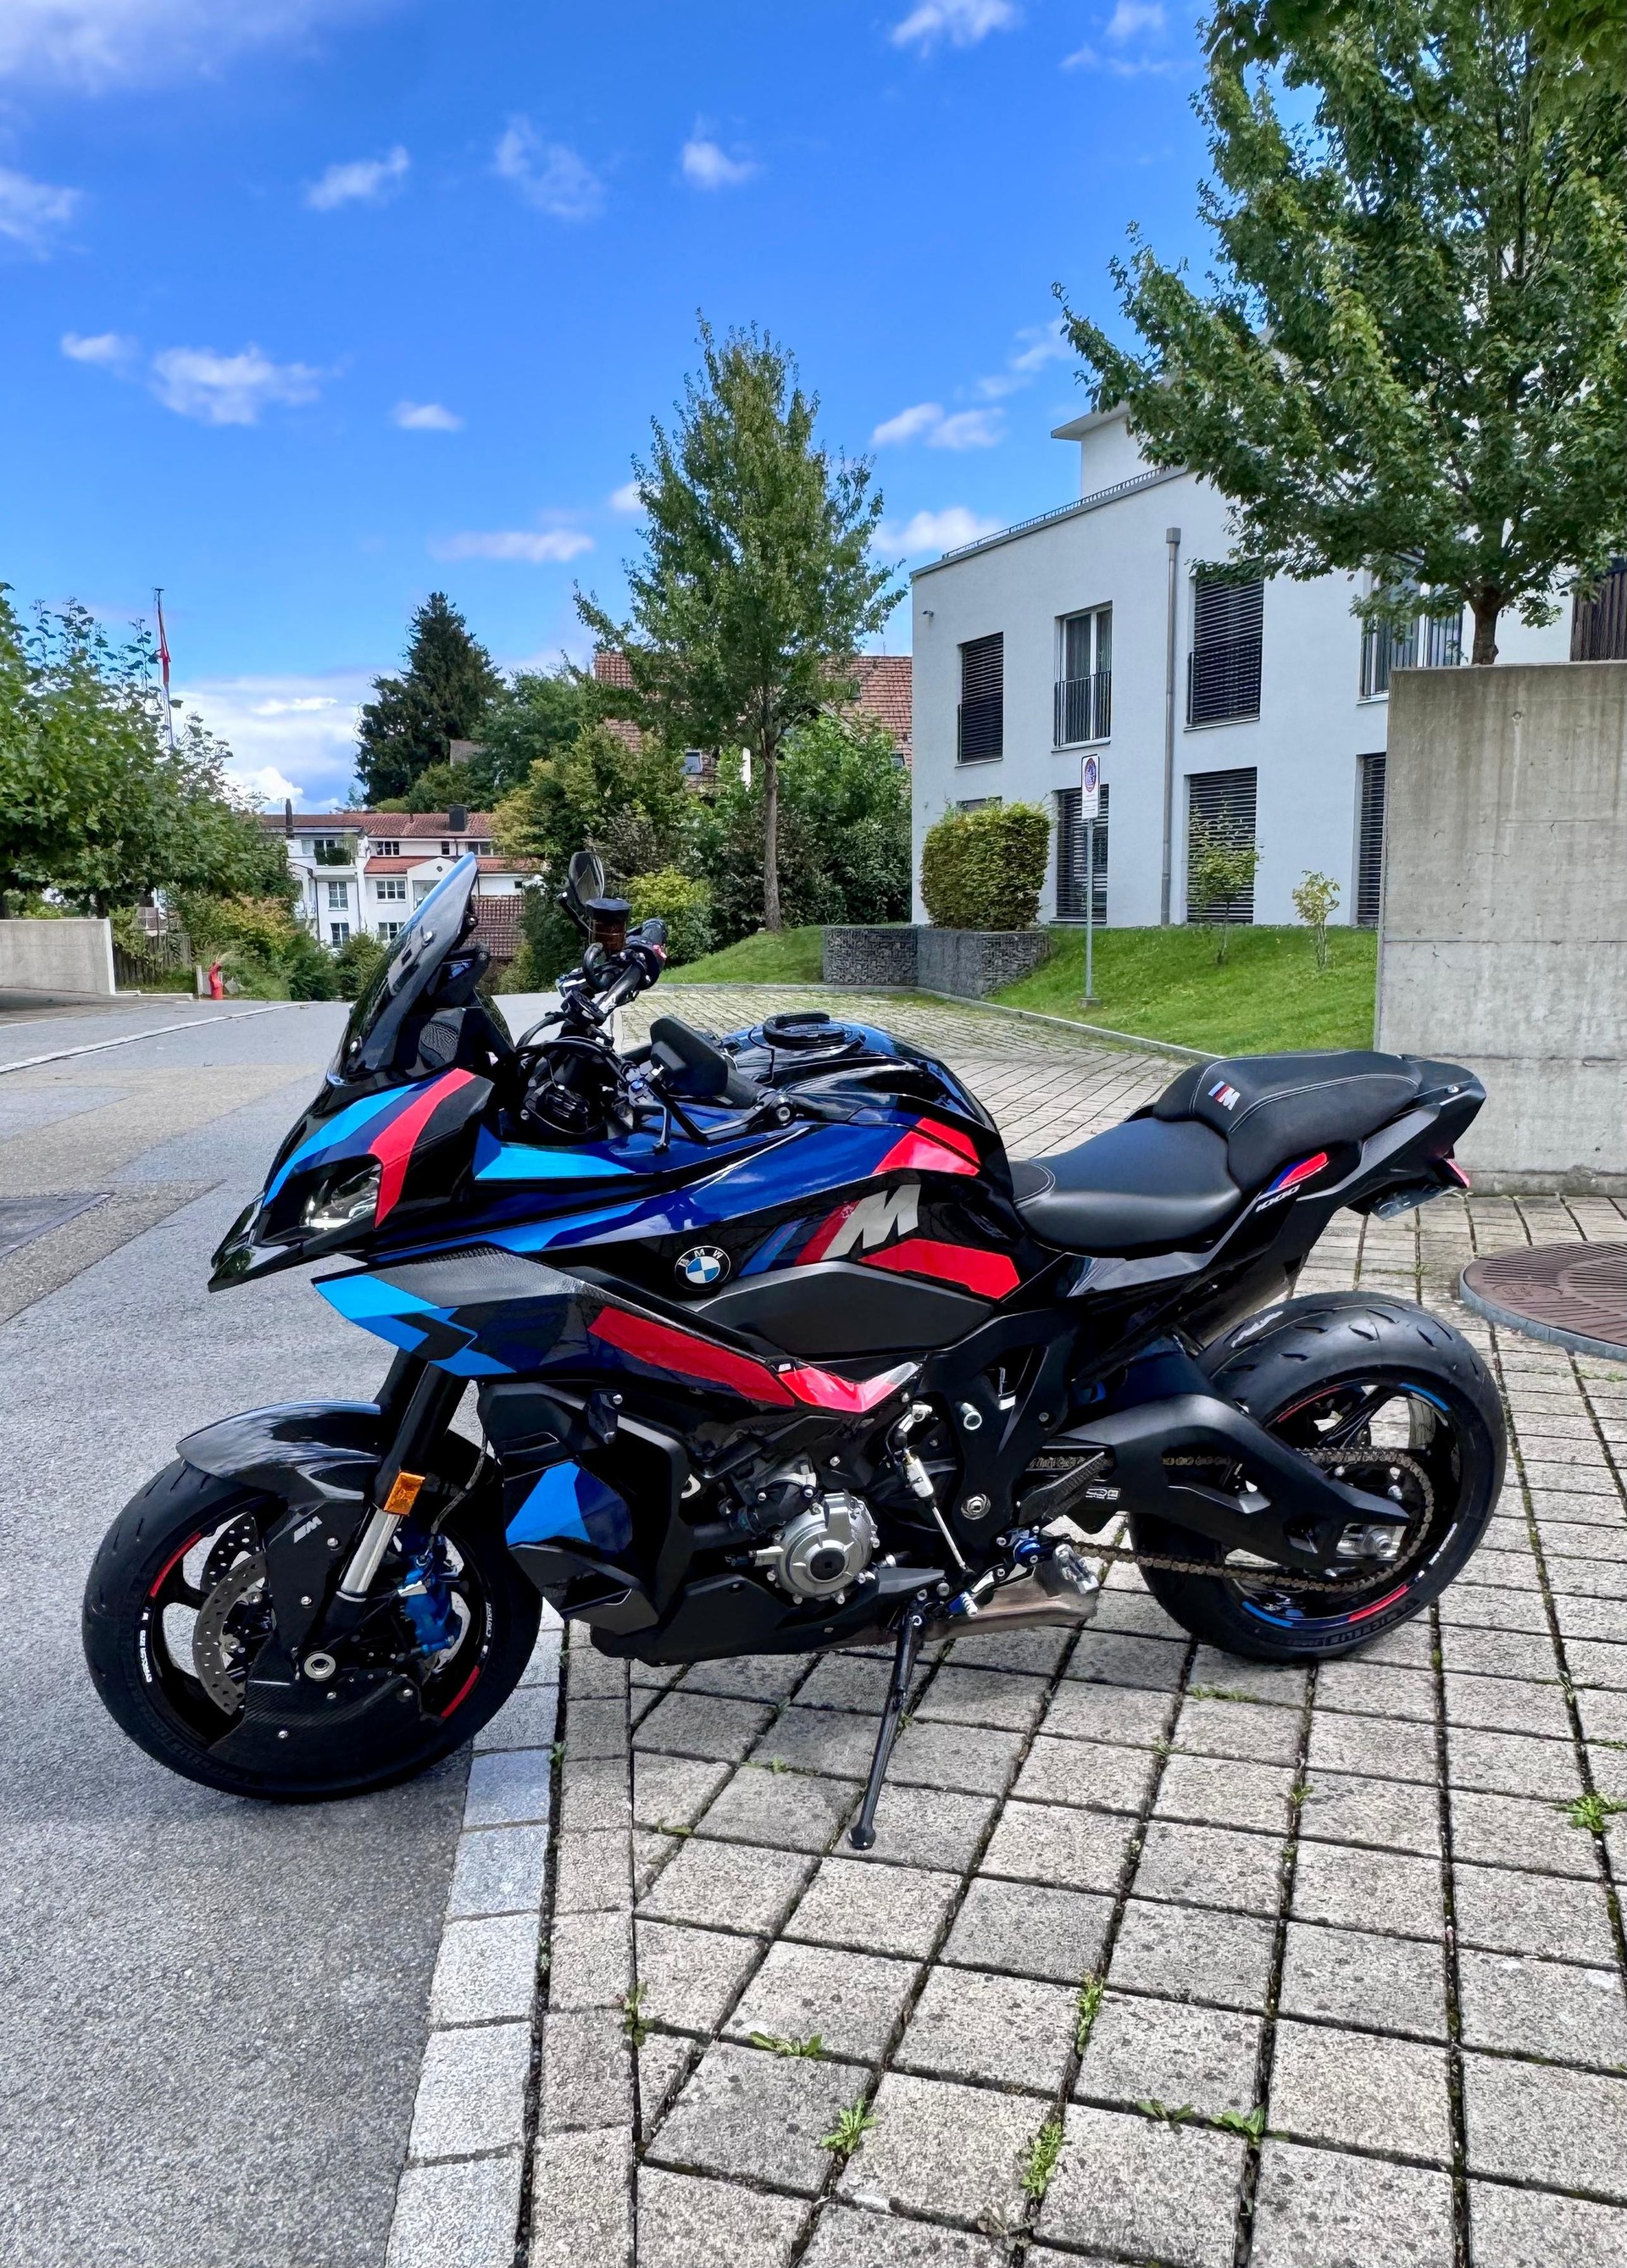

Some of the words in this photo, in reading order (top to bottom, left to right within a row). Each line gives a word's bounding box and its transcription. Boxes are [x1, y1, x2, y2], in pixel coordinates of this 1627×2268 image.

[1255, 1184, 1301, 1212] 1000
[819, 1184, 922, 1262] M
[678, 1248, 724, 1267] BMW
